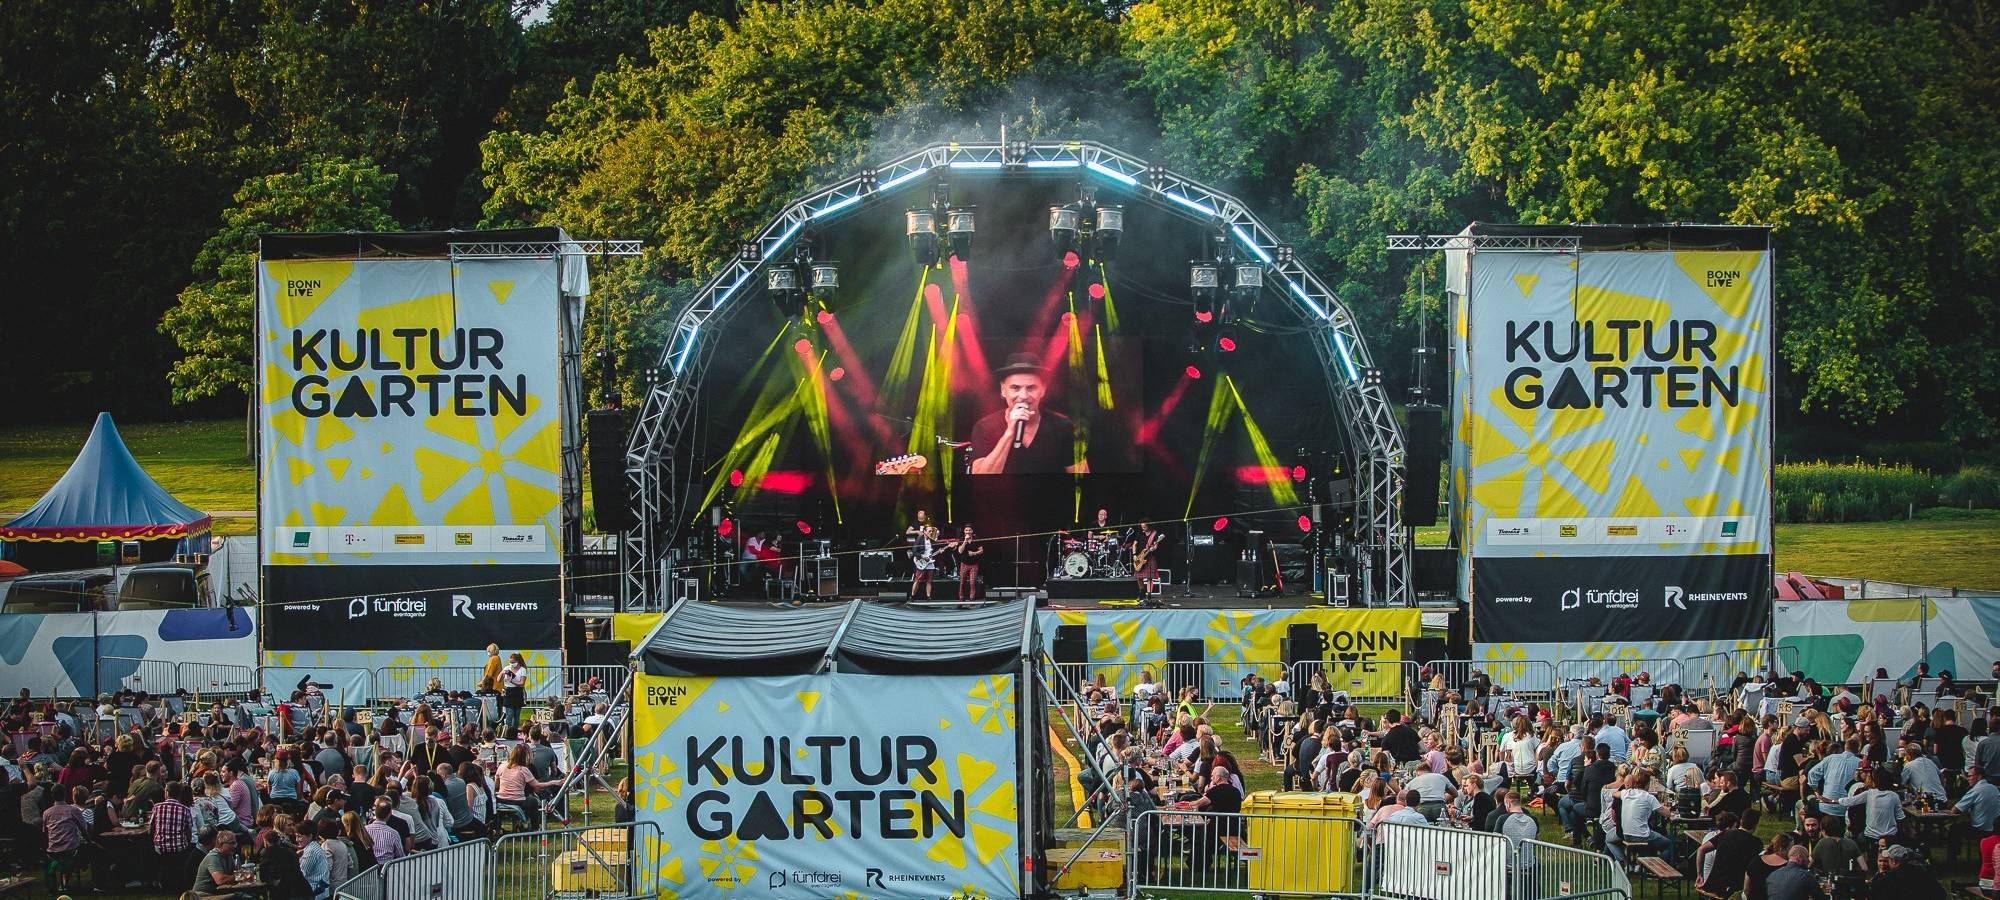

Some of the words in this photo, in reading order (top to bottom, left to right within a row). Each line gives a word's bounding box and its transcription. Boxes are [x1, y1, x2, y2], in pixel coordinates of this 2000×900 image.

[1707, 270, 1740, 279] BONN
[287, 279, 321, 288] BONN
[1707, 279, 1732, 288] LIVE
[287, 288, 313, 297] LIVE
[1505, 319, 1718, 365] KULTUR
[292, 327, 505, 373] KULTUR
[1503, 365, 1740, 411] GARTEN
[291, 373, 528, 418] GARTEN
[1495, 596, 1522, 604] powered
[1523, 596, 1533, 604] by
[1585, 588, 1639, 603] fünfdrei
[1688, 591, 1749, 602] RHEINEVENTS
[284, 603, 311, 611] powered
[311, 603, 321, 611] by
[372, 597, 427, 612] fünfdrei
[476, 601, 539, 611] RHEINEVENTS
[647, 686, 688, 696] BONN
[647, 696, 678, 706] LIVE
[686, 735, 938, 786] KULTUR
[686, 789, 967, 841] GARTEN
[707, 876, 734, 884] powered
[792, 870, 842, 883] fünfdrei
[889, 874, 946, 882] RHEINEVENTS
